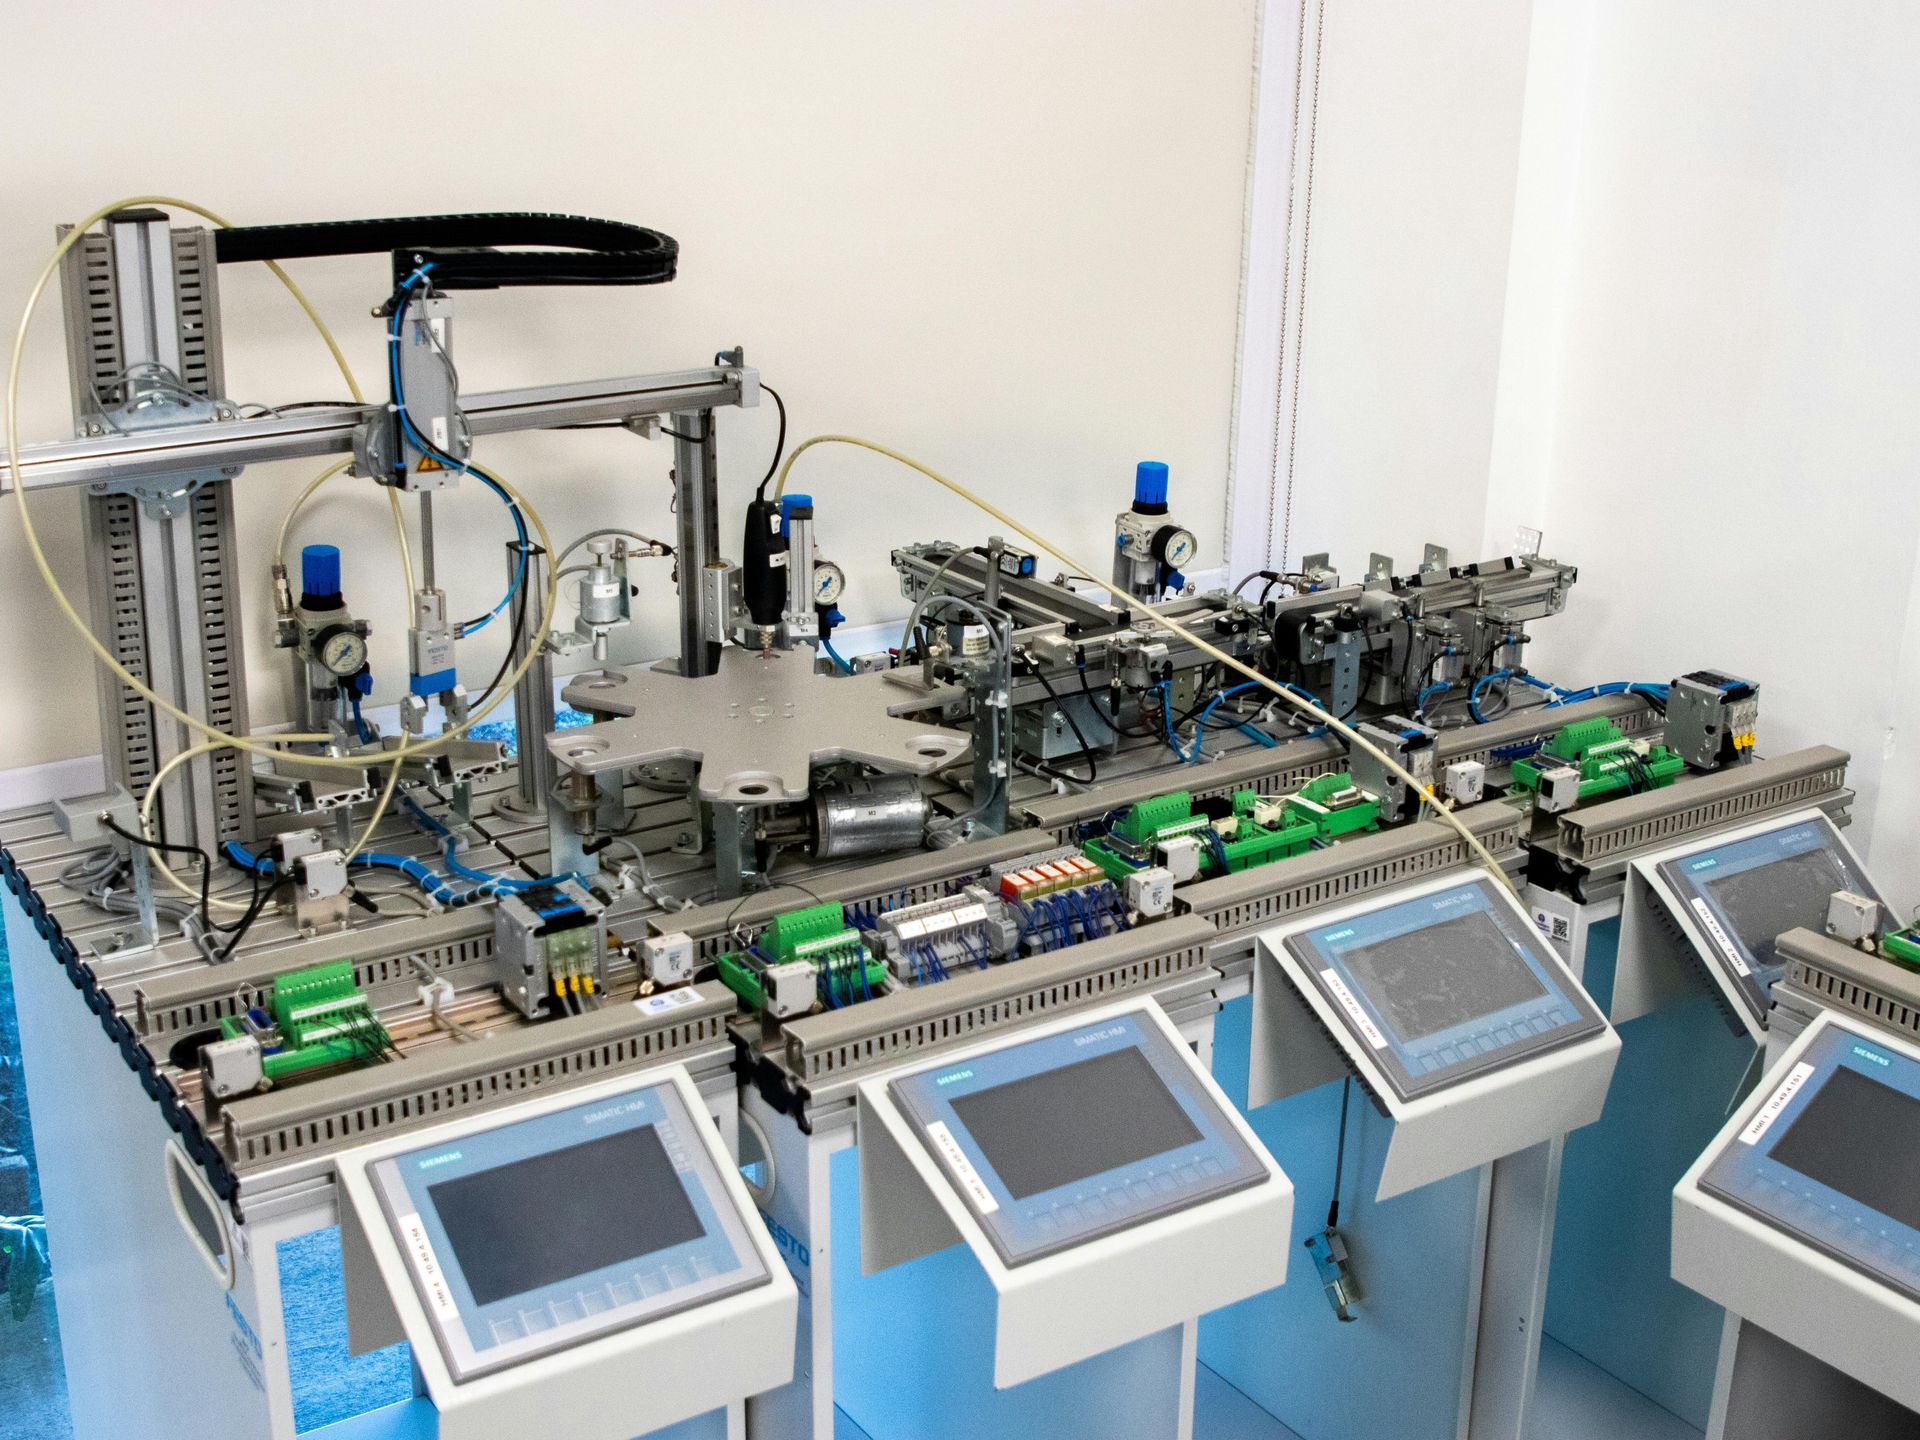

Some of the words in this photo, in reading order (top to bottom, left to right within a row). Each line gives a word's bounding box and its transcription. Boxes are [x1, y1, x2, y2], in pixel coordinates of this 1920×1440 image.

[1691, 858, 1717, 871] SIEMENS
[1324, 929, 1355, 942] SIEMENS
[1074, 1031, 1109, 1047] SIMATIC
[1853, 1046, 1889, 1067] SIEMENS
[936, 1069, 974, 1086] SIEMENS
[583, 1106, 624, 1124] SIMATIC
[418, 1151, 463, 1170] SIEMENS
